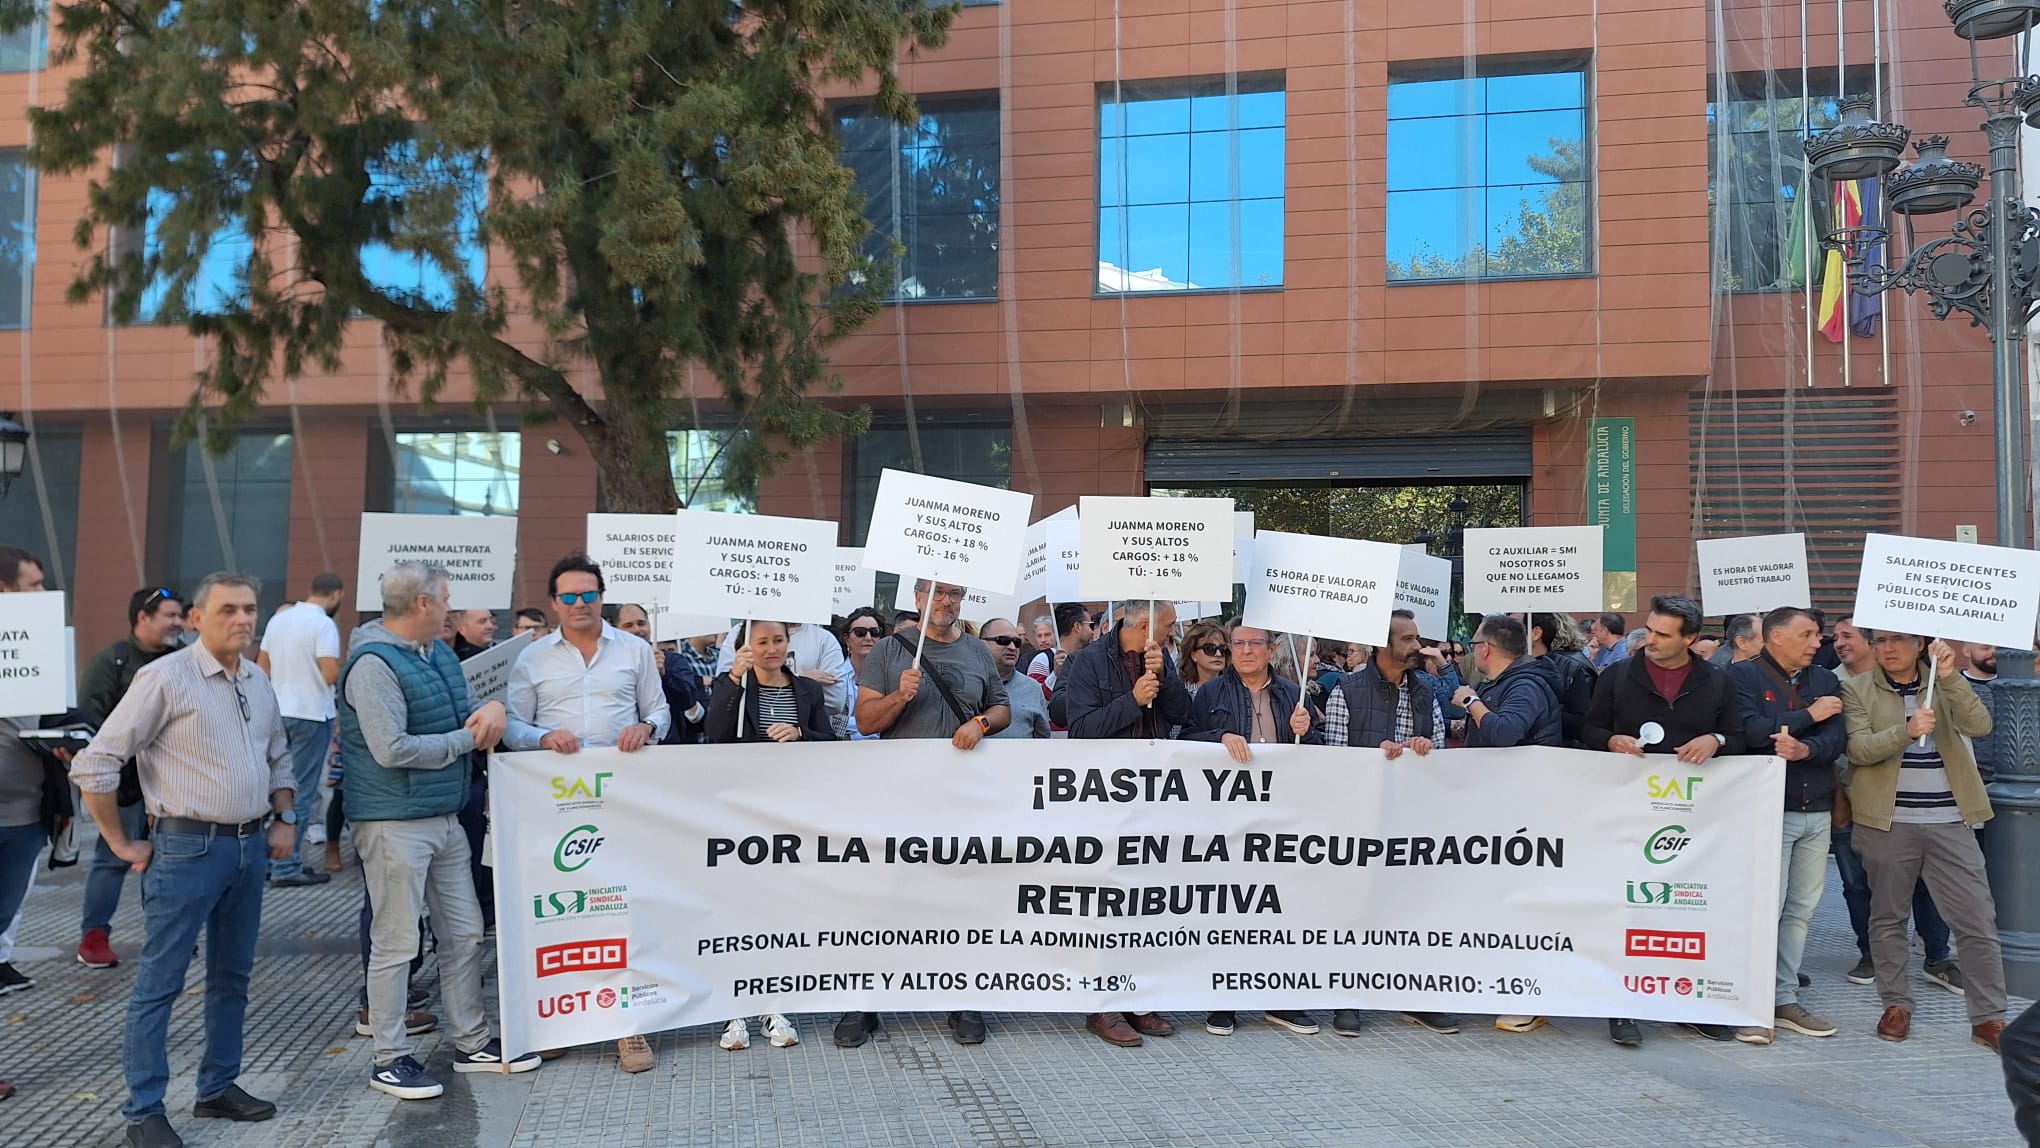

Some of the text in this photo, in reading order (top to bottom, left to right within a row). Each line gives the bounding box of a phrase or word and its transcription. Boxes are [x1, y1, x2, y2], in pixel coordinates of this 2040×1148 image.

[1621, 426, 1630, 459] GOBIERNO
[1622, 461, 1630, 473] DEL
[1597, 482, 1610, 495] DE
[904, 496, 1001, 522] JUANMA MORENO
[917, 514, 982, 534] Y SUS ALTOS
[1107, 521, 1205, 532] JUANMA MORENO
[606, 533, 655, 542] SALARIOS
[706, 536, 807, 553] JUANMA MORENO
[904, 527, 952, 544] CARGOS:
[962, 538, 976, 548] 18
[978, 541, 989, 551] %
[1122, 536, 1189, 547] Y SUS ALTOS
[387, 544, 491, 554] JUANMA MALTRATA
[623, 547, 674, 556] EN SERVIC
[917, 544, 935, 556] TÚ:
[943, 550, 957, 560] 16
[959, 553, 970, 563] %
[1061, 550, 1073, 559] ES
[1489, 547, 1501, 555] C2
[1503, 546, 1548, 555] AUXILIAR
[1559, 546, 1577, 554] SMI
[602, 558, 652, 569] PÚBLICOS
[654, 561, 667, 569] DE
[721, 553, 791, 567] Y SUS ALTOS
[1112, 551, 1161, 562] CARGOS:
[1173, 553, 1185, 562] 18
[1187, 553, 1199, 562] %
[1499, 559, 1566, 568] NOSOTROS SI
[835, 564, 856, 572] RENO
[1128, 564, 1147, 577] TÚ:
[1156, 568, 1169, 577] 16
[1171, 568, 1182, 577] %
[1724, 566, 1746, 574] HORA
[1747, 565, 1757, 573] DE
[1759, 562, 1794, 572] VALORAR
[1886, 556, 2017, 579] SALARIOS DECENTES
[610, 574, 650, 583] ¡SUBIDA
[709, 567, 760, 580] CARGOS:
[773, 573, 786, 582] 18
[788, 573, 800, 583] %
[1266, 568, 1376, 590] ES HORA DE VALORAR
[1486, 571, 1580, 582] QUE NO LLEGAMOS
[1718, 574, 1791, 586] NUESTRO TRABAJO
[1905, 572, 1992, 591] EN SERVICIOS
[725, 582, 745, 595] TÚ:
[755, 587, 768, 596] 16
[770, 587, 782, 597] %
[1269, 583, 1369, 605] NUESTRO TRABAJO
[1400, 580, 1409, 590] DE
[1410, 582, 1439, 596] VALORAR
[1510, 585, 1526, 593] FIN
[1528, 585, 1541, 593] DE
[1544, 585, 1564, 593] MES
[968, 594, 987, 604] MES
[1405, 594, 1436, 608] TRABAJO
[1877, 583, 2018, 609] PÚBLICOS DE CALIDAD
[1884, 599, 2005, 622] ¡SUBIDA SALARIAL!
[1033, 768, 1273, 810] ¡BASTA YA!
[706, 827, 1564, 868] POR LA IGUALDAD EN LA RECUPERACIÓN
[589, 885, 628, 895] INICIATIVA
[1674, 882, 1708, 890] INICIATIVA
[589, 894, 623, 904] SINDICAL
[1017, 884, 1282, 917] RETRIBUTIVA
[1674, 890, 1703, 898] SINDICAL
[589, 902, 628, 912] ANDALUZA
[1674, 898, 1707, 906] ANDALUZA
[698, 926, 1574, 956] PERSONAL FUNCIONARIO DE LA ADMINISTRACIÓN GENERAL DE LA JUNTA DE ANDALUCÍA
[1631, 935, 1700, 954] CCOO
[542, 945, 621, 971] CCOO
[733, 972, 1137, 997] PRESIDENTE Y ALTOS CARGOS: +18%
[1211, 972, 1542, 996] PERSONAL FUNCIONARIO: -16%
[1624, 975, 1671, 995] UGT
[537, 990, 591, 1018] UGT
